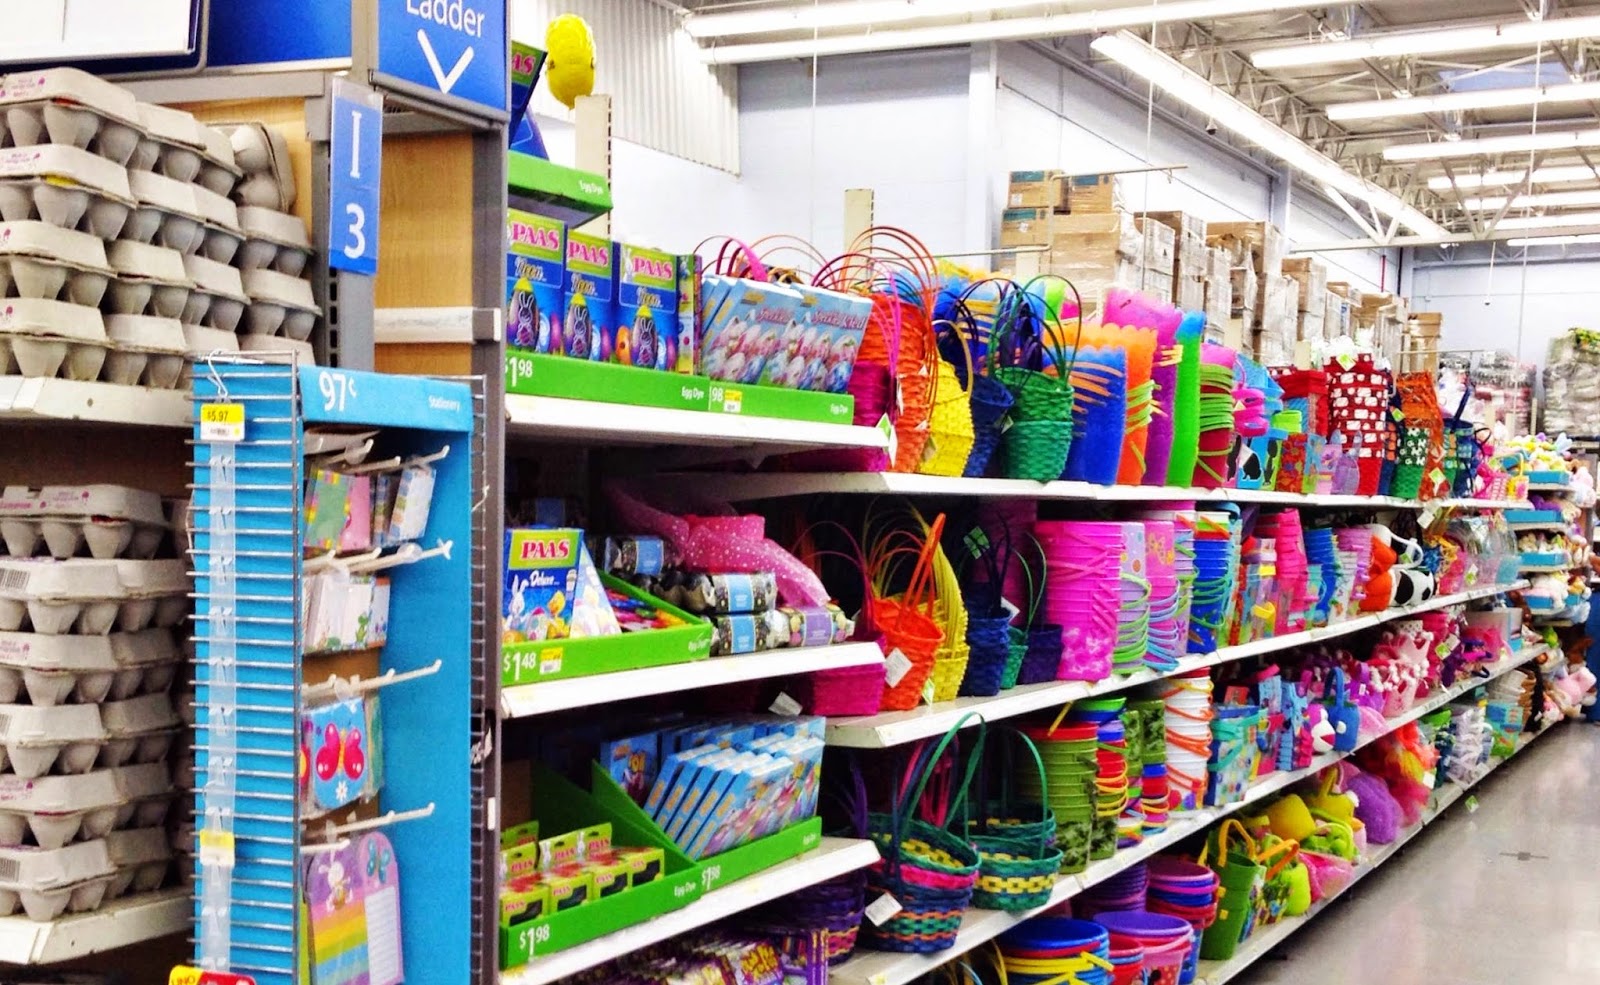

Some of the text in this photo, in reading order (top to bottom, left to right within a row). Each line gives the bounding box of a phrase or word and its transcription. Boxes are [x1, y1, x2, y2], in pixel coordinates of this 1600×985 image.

[406, 0, 485, 38] Ladder
[512, 52, 535, 75] AS
[344, 203, 365, 258] 3
[511, 222, 560, 250] PAAS
[567, 239, 608, 267] PAAS
[633, 256, 673, 280] PAAS
[521, 539, 570, 559] PAAS
